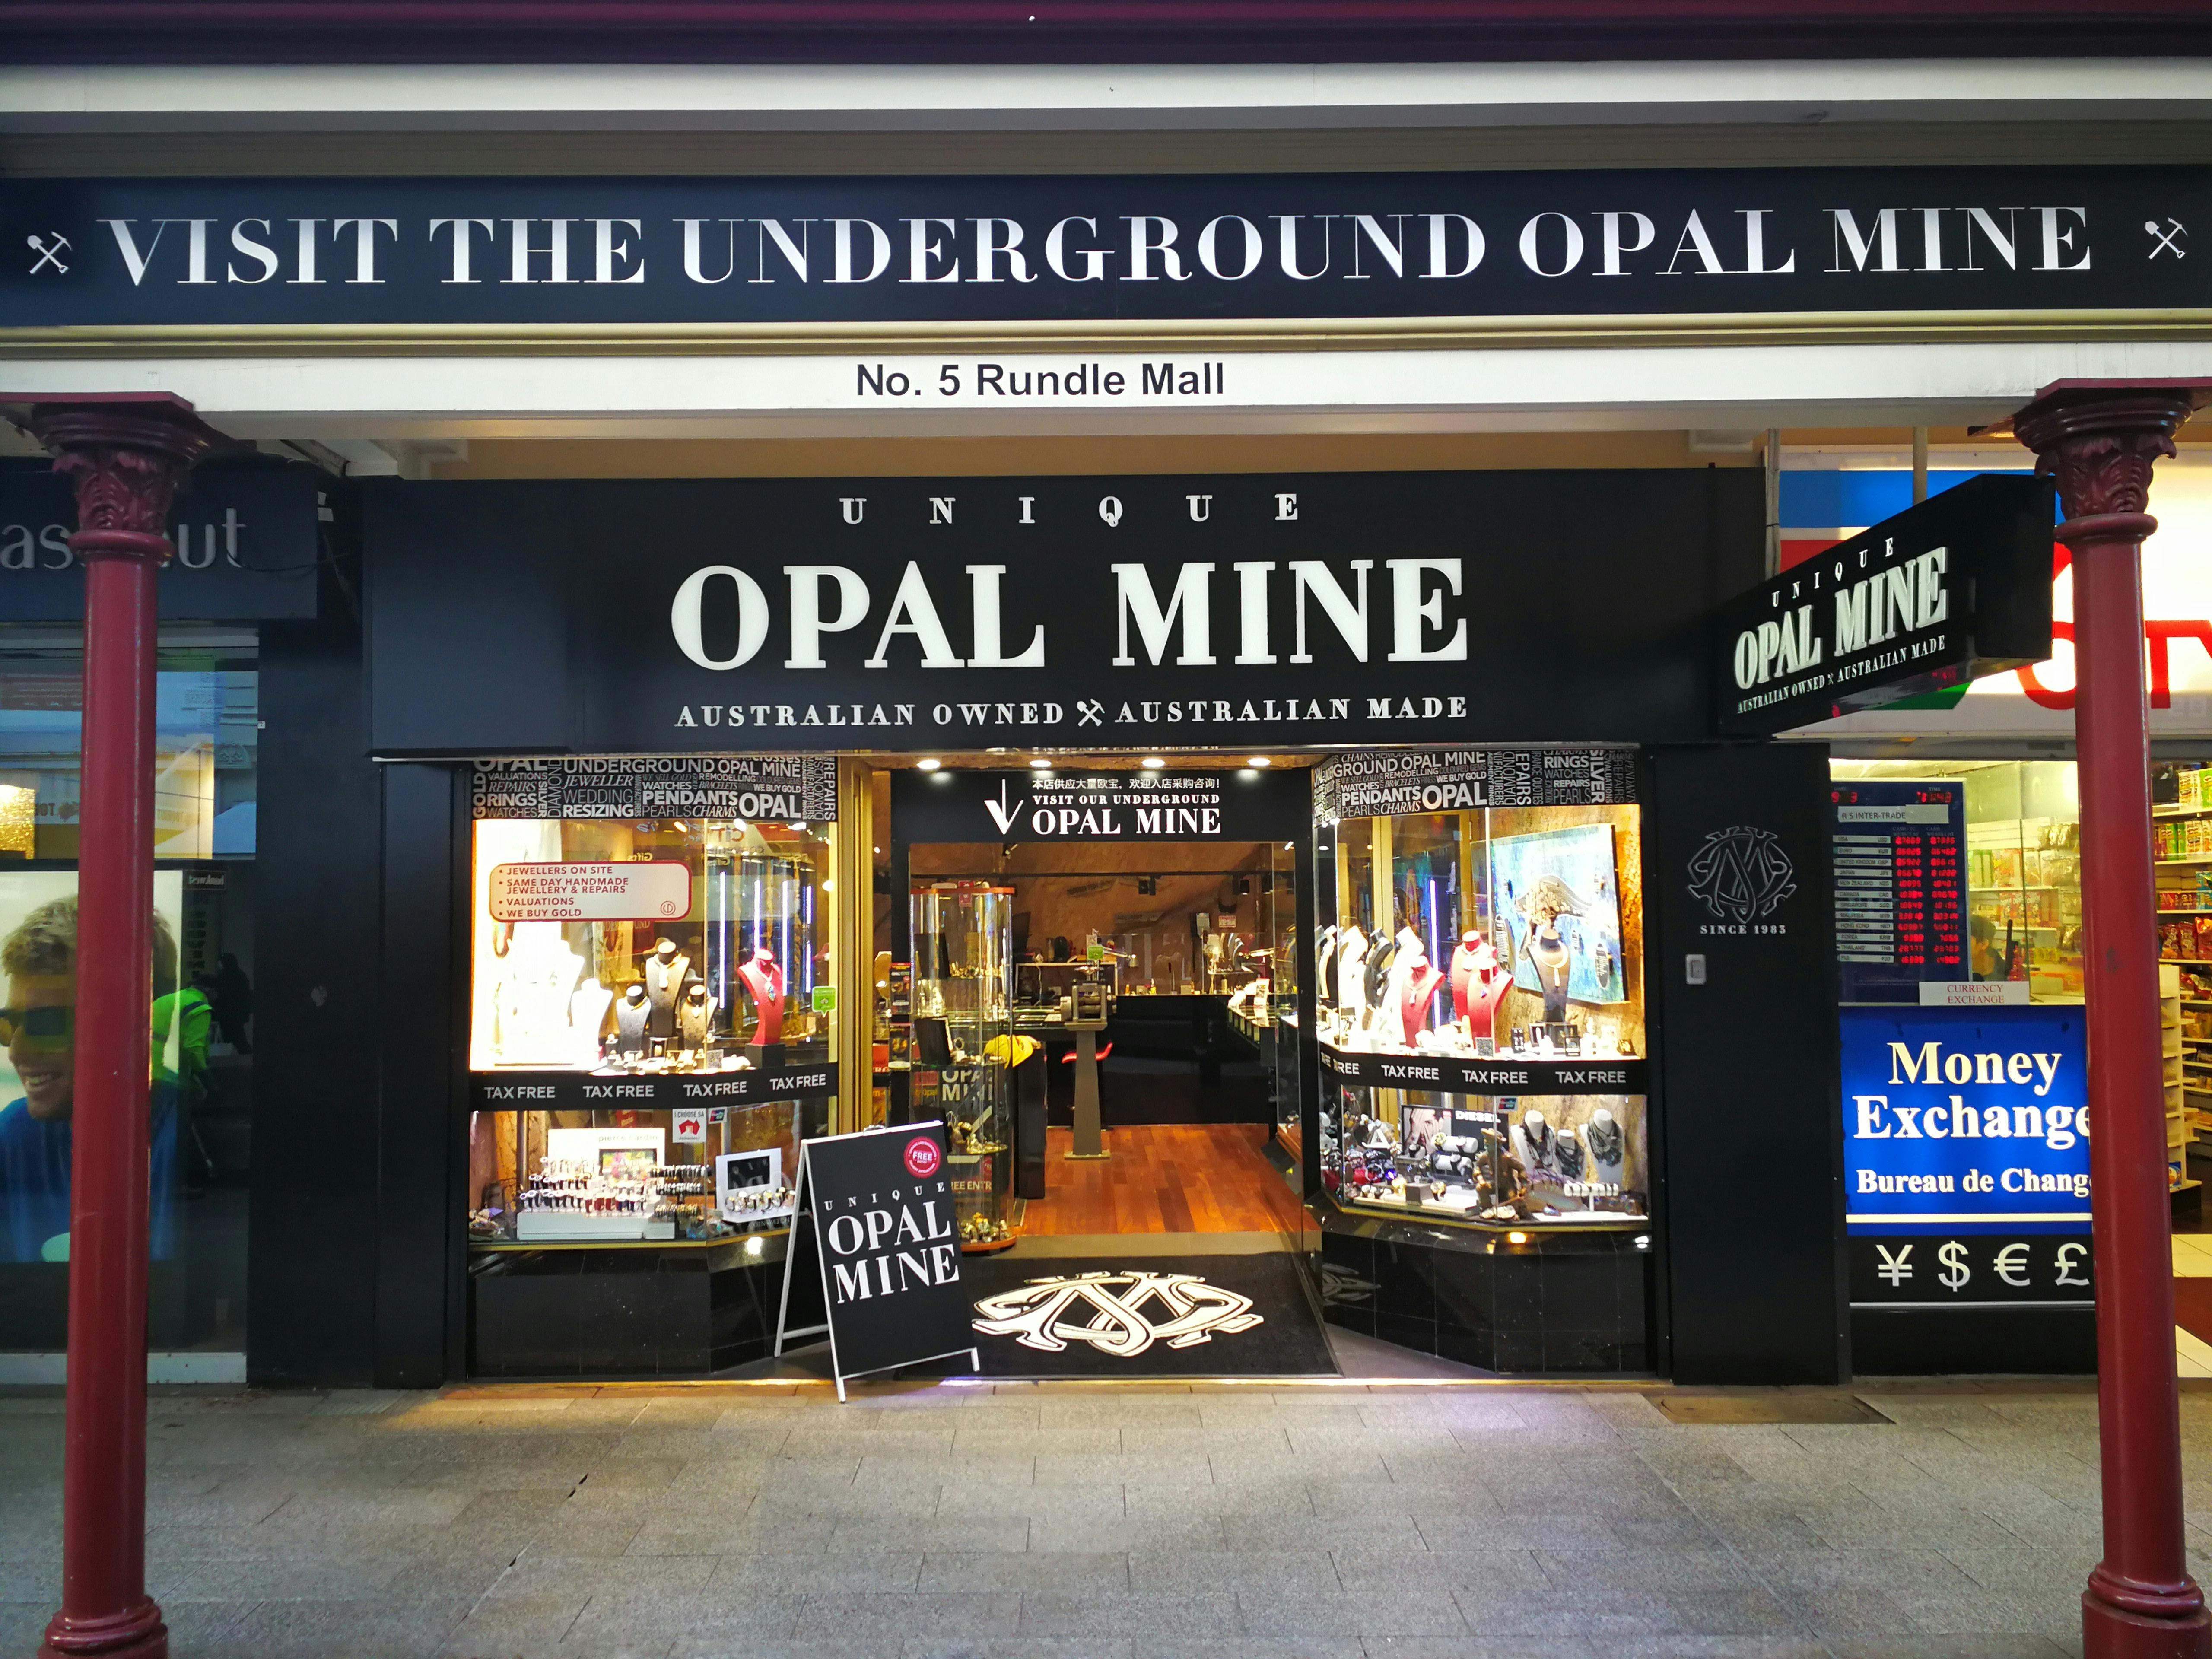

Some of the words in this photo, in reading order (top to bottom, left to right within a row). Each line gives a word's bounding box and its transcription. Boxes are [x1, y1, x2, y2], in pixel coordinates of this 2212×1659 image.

[108, 219, 397, 286] VISIT
[430, 219, 644, 283] THE
[673, 214, 1485, 283] UNDERGROUND
[1519, 209, 1794, 276] OPAL
[1823, 208, 2090, 272] MINE
[856, 364, 921, 396] No.
[939, 365, 960, 396] 5
[977, 364, 1124, 395] Rundle
[1142, 362, 1223, 394] Mall
[840, 494, 1297, 527] UNIQUE
[0, 524, 86, 569] as
[158, 508, 247, 568] ut
[1773, 537, 1893, 607] UNIQUE
[671, 561, 1044, 670] OPAL
[1111, 559, 1467, 666] MINE
[1734, 605, 1821, 689] OPAL
[1834, 547, 1947, 657] MINE
[1737, 686, 1789, 713] AUSTRALIAN
[1792, 674, 1825, 696] OWNED
[1837, 647, 1906, 682] AUSTRALIAN
[1911, 635, 1945, 659] MADE
[674, 704, 915, 726] AUSTRALIAN
[933, 703, 1063, 725] OWNED
[1117, 700, 1350, 726] AUSTRALIAN
[1367, 697, 1466, 718] MADE
[563, 759, 714, 773] UNDERGROUND
[718, 760, 759, 775] OPAL
[763, 763, 801, 777] MINE
[1401, 753, 1441, 770] OPAL
[1445, 752, 1486, 766] MINE
[1532, 751, 1542, 776] RANCE
[1544, 755, 1590, 768] RINGS
[699, 773, 756, 782] REMODELLING
[1384, 767, 1439, 779] REMODELLING
[1437, 774, 1448, 782] WE
[1449, 772, 1465, 782] BUY
[1465, 771, 1487, 781] GOLD
[1494, 751, 1503, 805] NUFACTURERS
[1516, 751, 1531, 805] EPAIRS
[1544, 769, 1590, 779] WATCHES
[1590, 750, 1605, 804] SILVER
[489, 782, 537, 792] REPAIRS
[563, 775, 633, 788] JEWELLER
[699, 781, 737, 790] BRACELETS
[1341, 781, 1379, 791] WATCHES
[1385, 777, 1421, 788] BRACELETS
[1554, 779, 1590, 788] REPAIRS
[1605, 760, 1614, 804] VALUATIONS
[1613, 759, 1624, 804] REPAIRS
[473, 773, 486, 818] GOLD
[563, 789, 633, 804] WEDDING
[642, 790, 738, 805] PENDANTS
[814, 761, 824, 820] DIAMONDS
[824, 762, 836, 820] REPAIRS
[1342, 786, 1421, 806] PENDANTS
[1422, 782, 1487, 810] OPAL
[1533, 777, 1544, 805] QUOTES
[1554, 788, 1591, 804] PEARLS
[487, 793, 537, 806] RINGS
[538, 781, 547, 818] SILVER
[738, 792, 801, 818] OPAL
[1032, 795, 1073, 804] VISIT
[1079, 795, 1108, 804] OUR
[1114, 794, 1220, 804] UNDERGROUND
[487, 807, 537, 817] WATCHES
[563, 805, 634, 817] RESIZING
[642, 805, 691, 817] PEARLS
[693, 805, 737, 817] CHARMS
[1342, 804, 1381, 817] PEARLS
[1381, 801, 1421, 814] CHARMS
[1032, 809, 1121, 834] OPAL
[1136, 808, 1221, 833] MINE
[507, 867, 566, 875] JEWELLERS
[507, 886, 567, 894] JEWELLERY
[582, 885, 626, 893] REPAIRS
[566, 877, 629, 886] HANDMADE
[507, 897, 574, 906] VALUATIONS
[551, 909, 582, 917] GOLD
[1700, 925, 1747, 934] SINCE
[1947, 985, 2004, 993] CURRENCY
[1947, 995, 2004, 1004] EXCHANGE
[1381, 1065, 1405, 1078] TAX
[1408, 1066, 1440, 1081] FREE
[1462, 1069, 1488, 1083] TAX
[1490, 1071, 1529, 1084] FREE
[1556, 1071, 1585, 1084] TAX
[1588, 1070, 1626, 1084] FREE
[1887, 1042, 2063, 1096] Money
[683, 1084, 713, 1097] TAX
[715, 1081, 748, 1096] FREE
[769, 1077, 795, 1091] TAX
[796, 1074, 827, 1088] FREE
[484, 1086, 515, 1099] TAX
[518, 1086, 556, 1099] FREE
[582, 1085, 613, 1098] TAX
[616, 1085, 655, 1098] FREE
[1455, 1110, 1501, 1123] DIESEL
[1852, 1095, 2090, 1150] Exchange
[912, 1151, 933, 1161] FREE
[967, 1181, 992, 1190] ENTR
[1856, 1169, 1955, 1194] Bureau
[1963, 1169, 1994, 1192] de
[2000, 1168, 2092, 1198] Chang
[824, 1182, 944, 1211] UNIQUE
[828, 1201, 951, 1255] OPAL
[833, 1244, 960, 1304] MINE
[1875, 1245, 1913, 1287] ¥
[1938, 1241, 1970, 1292] $
[1993, 1243, 2031, 1287] €
[2054, 1243, 2090, 1286] £
